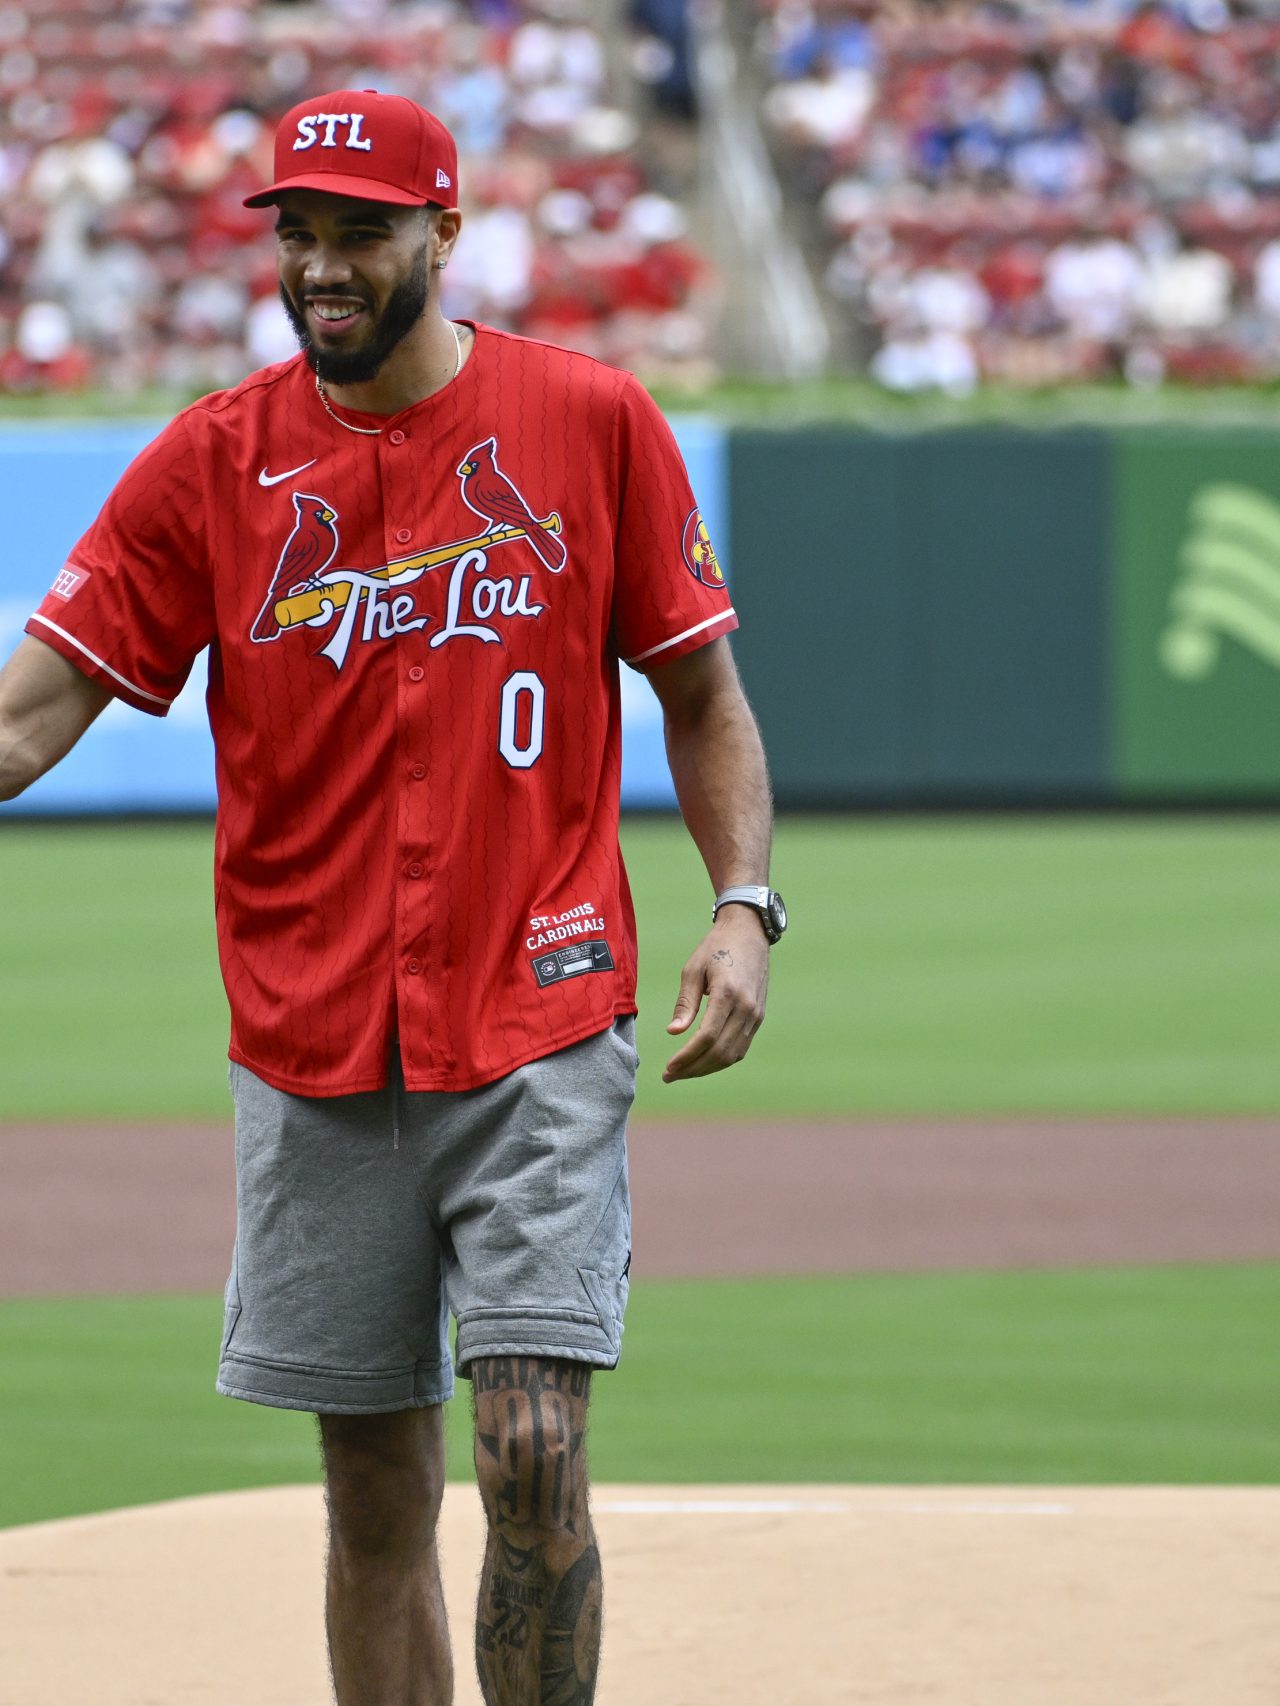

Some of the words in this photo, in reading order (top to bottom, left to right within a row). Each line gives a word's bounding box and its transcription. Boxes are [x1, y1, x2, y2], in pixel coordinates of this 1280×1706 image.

[293, 112, 372, 151] STL
[304, 564, 430, 672] The
[429, 548, 545, 649] Lou
[497, 669, 547, 771] 0
[526, 917, 605, 950] CARDINALS
[529, 915, 551, 931] ST.
[552, 902, 595, 925] LOUIS
